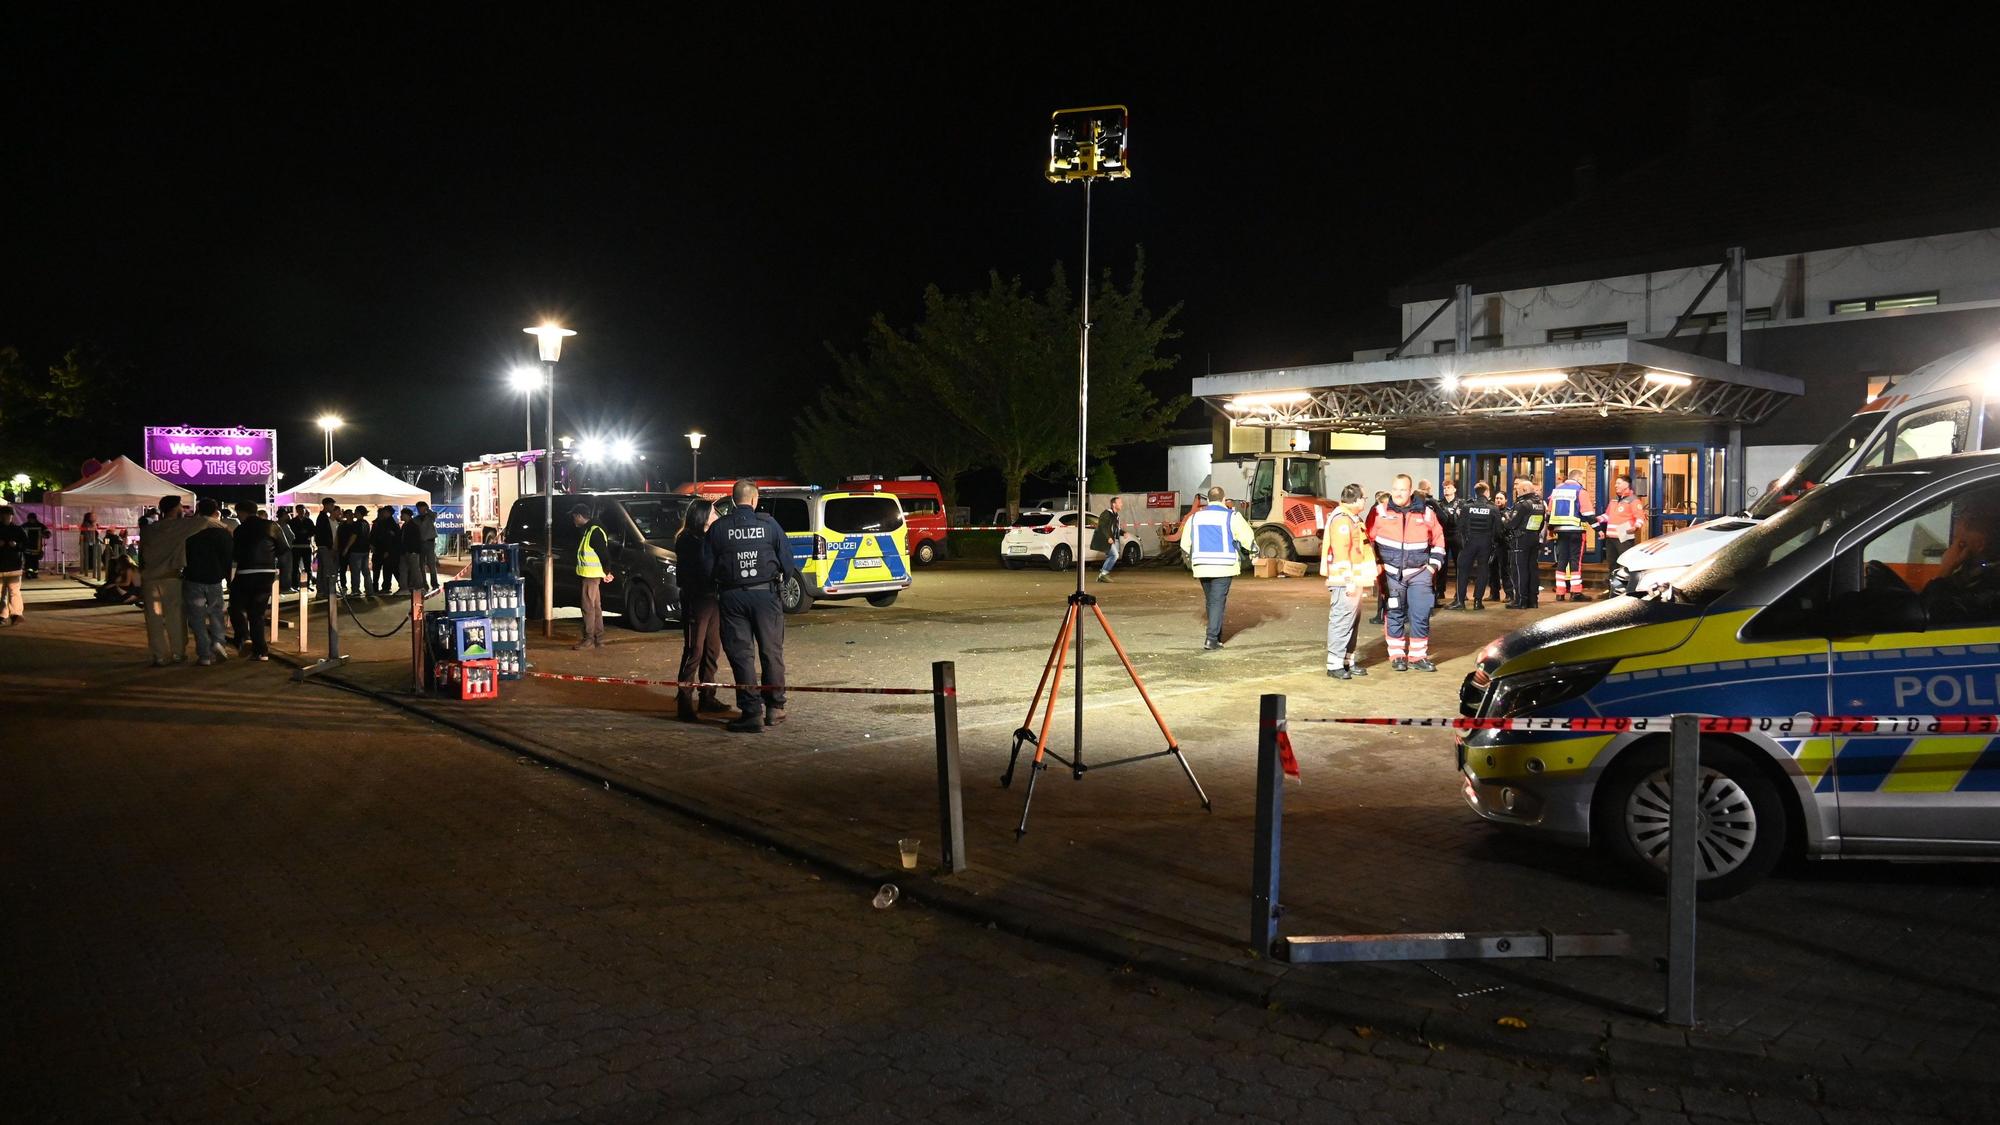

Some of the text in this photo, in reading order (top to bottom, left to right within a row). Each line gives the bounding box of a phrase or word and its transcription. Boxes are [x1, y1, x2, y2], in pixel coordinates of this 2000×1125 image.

[169, 443, 253, 456] Welcome to
[151, 459, 180, 475] WE
[204, 460, 237, 475] THE
[1468, 507, 1491, 515] POLIZEI
[433, 521, 464, 529] olksban
[728, 527, 765, 540] POLIZEI
[827, 541, 857, 550] POLIZEI
[737, 550, 758, 560] NRW
[739, 559, 757, 569] DHF
[1704, 716, 1795, 732] POLIZ
